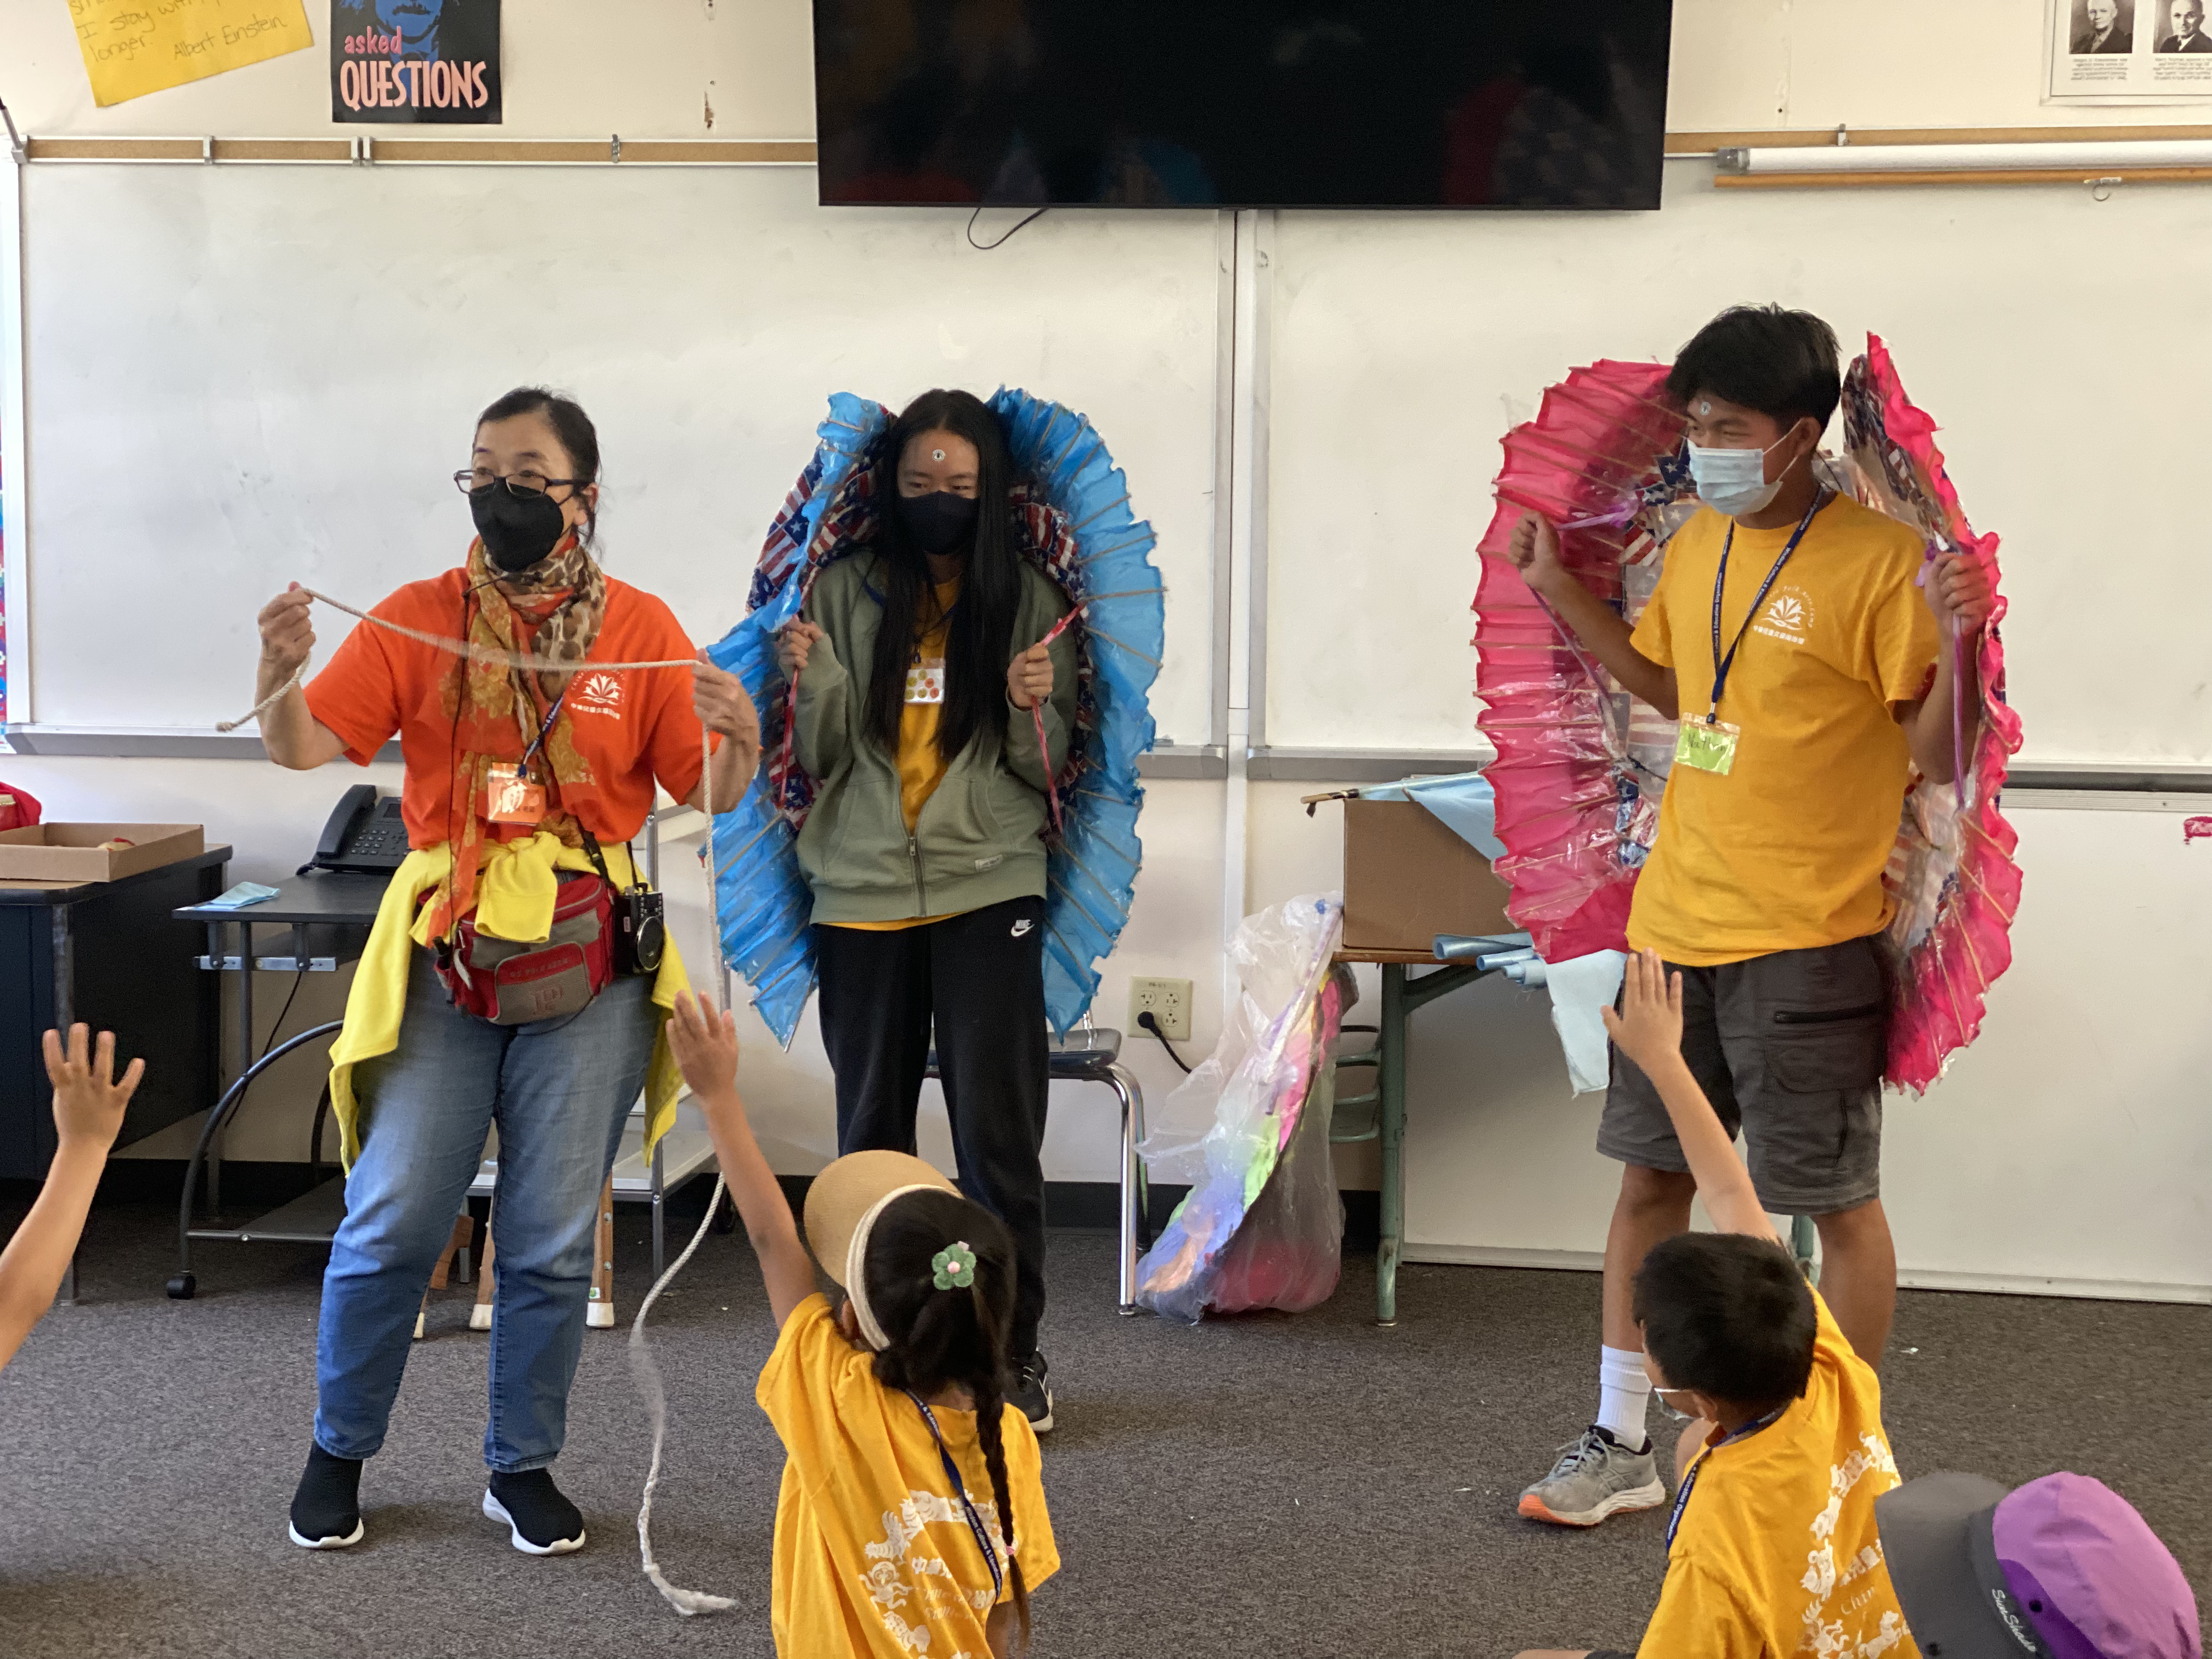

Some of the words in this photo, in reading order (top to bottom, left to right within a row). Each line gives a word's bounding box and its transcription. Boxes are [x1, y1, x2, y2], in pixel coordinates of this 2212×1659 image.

[76, 21, 98, 40] I
[109, 10, 156, 33] stay
[174, 31, 216, 60] Albert
[221, 13, 288, 45] Einstein
[344, 25, 402, 55] asked
[340, 59, 489, 112] QUESTIONS
[1679, 1471, 1695, 1503] Education
